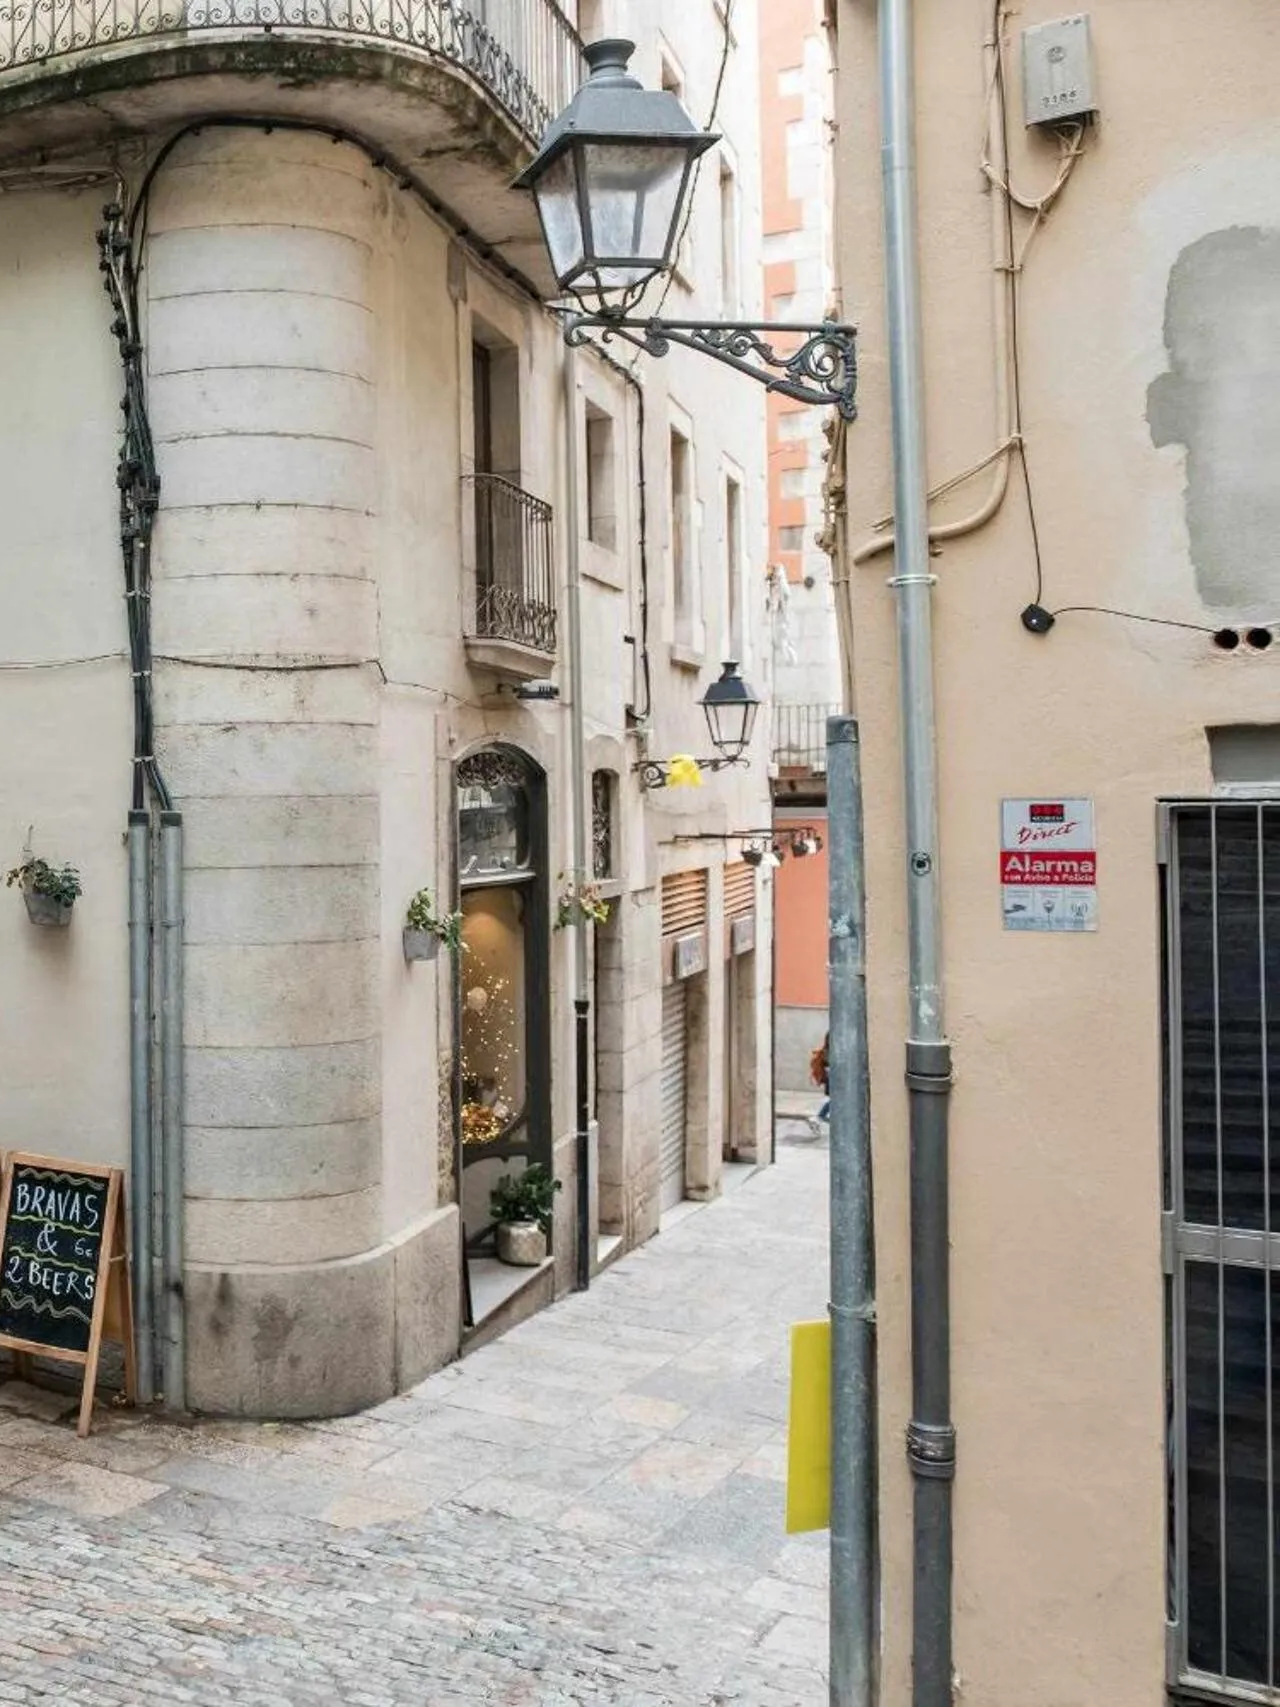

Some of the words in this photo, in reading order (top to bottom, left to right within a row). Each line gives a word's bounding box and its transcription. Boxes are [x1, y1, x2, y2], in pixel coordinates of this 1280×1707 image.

[1005, 854, 1094, 873] Alarma
[16, 1183, 99, 1230] BRAVAS
[36, 1222, 59, 1257] &
[4, 1255, 23, 1283] 2
[28, 1260, 96, 1300] BEERS
